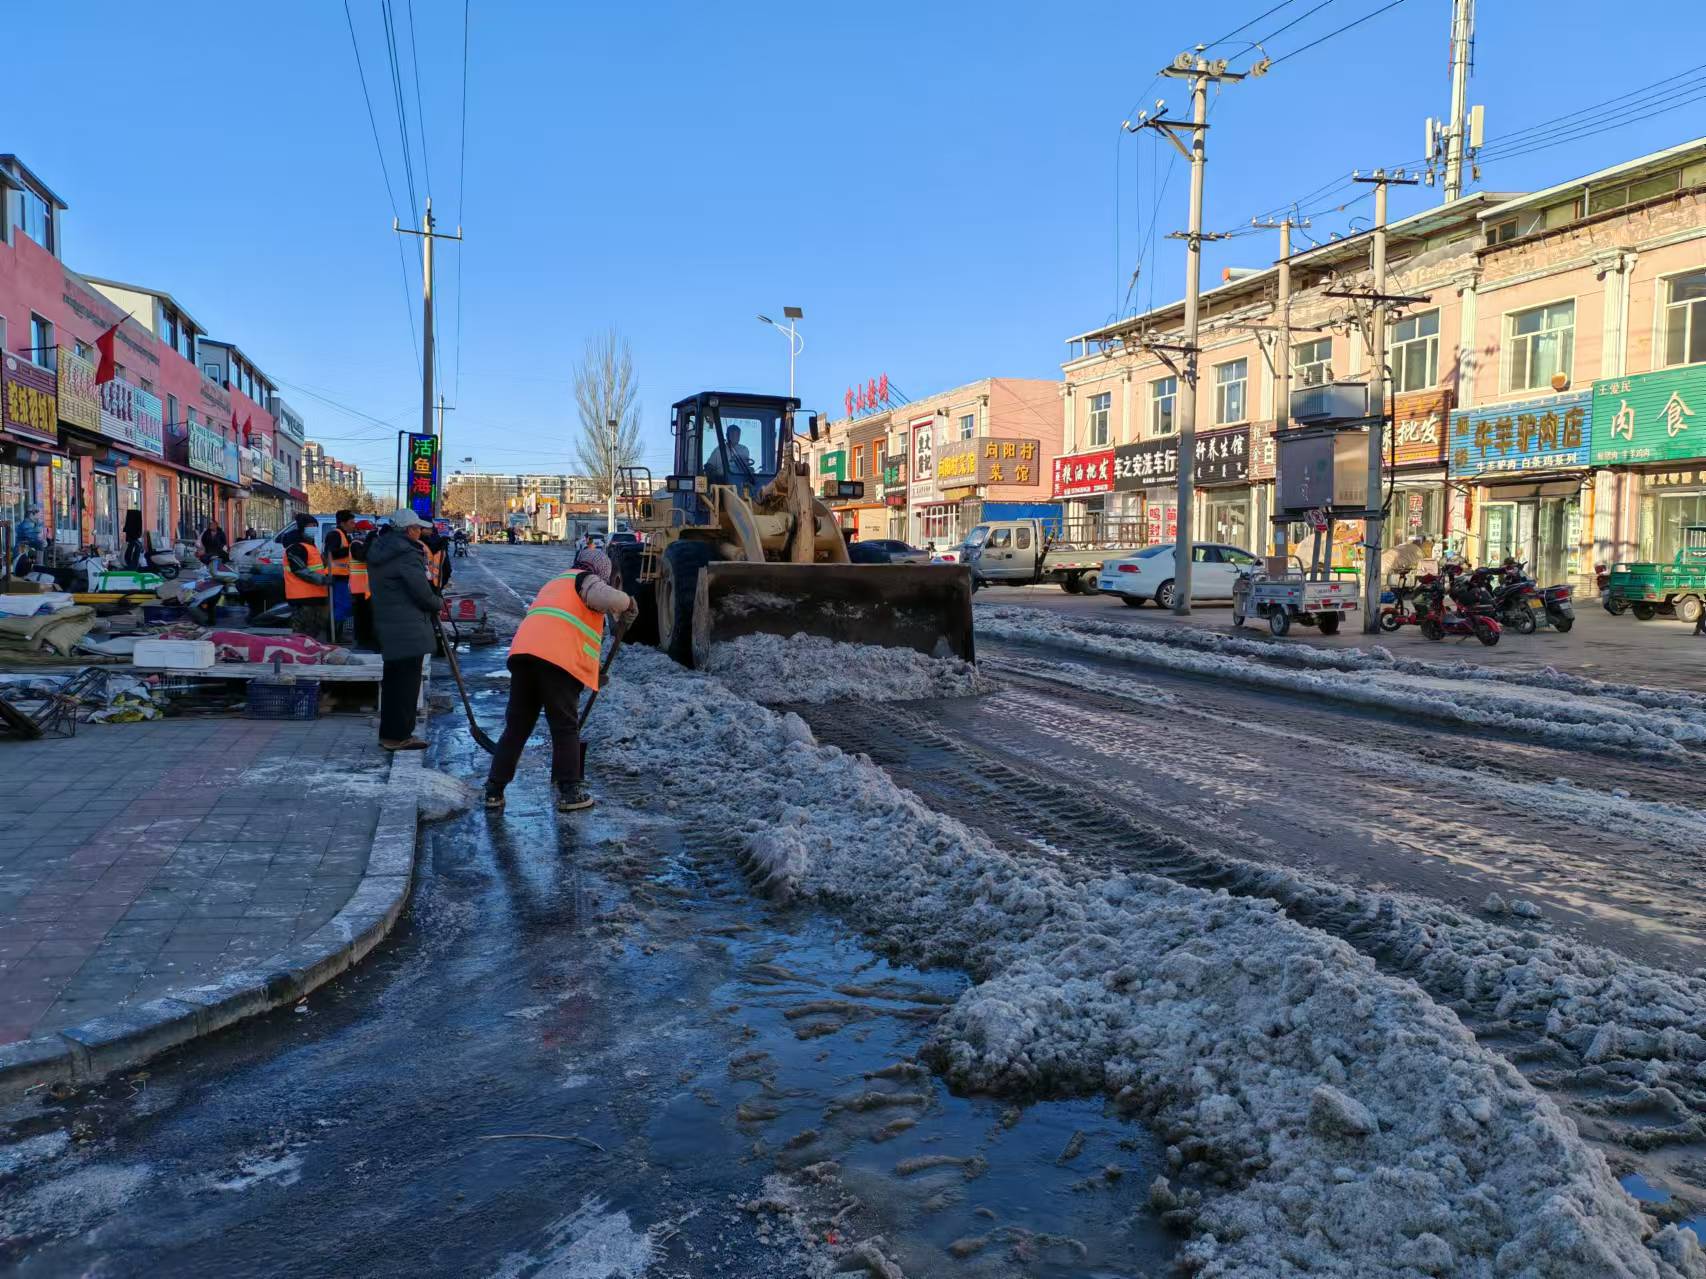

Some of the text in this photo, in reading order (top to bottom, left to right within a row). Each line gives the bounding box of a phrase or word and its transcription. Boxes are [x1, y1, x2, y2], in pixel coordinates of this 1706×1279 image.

[1611, 391, 1696, 441] 肉食
[1474, 406, 1585, 457] 牛羊驴肉店
[985, 441, 1036, 459] 向阳村
[1114, 449, 1177, 479] 车之安洗车行
[990, 464, 1030, 481] 菜馆
[1062, 458, 1109, 484] 粮油批发
